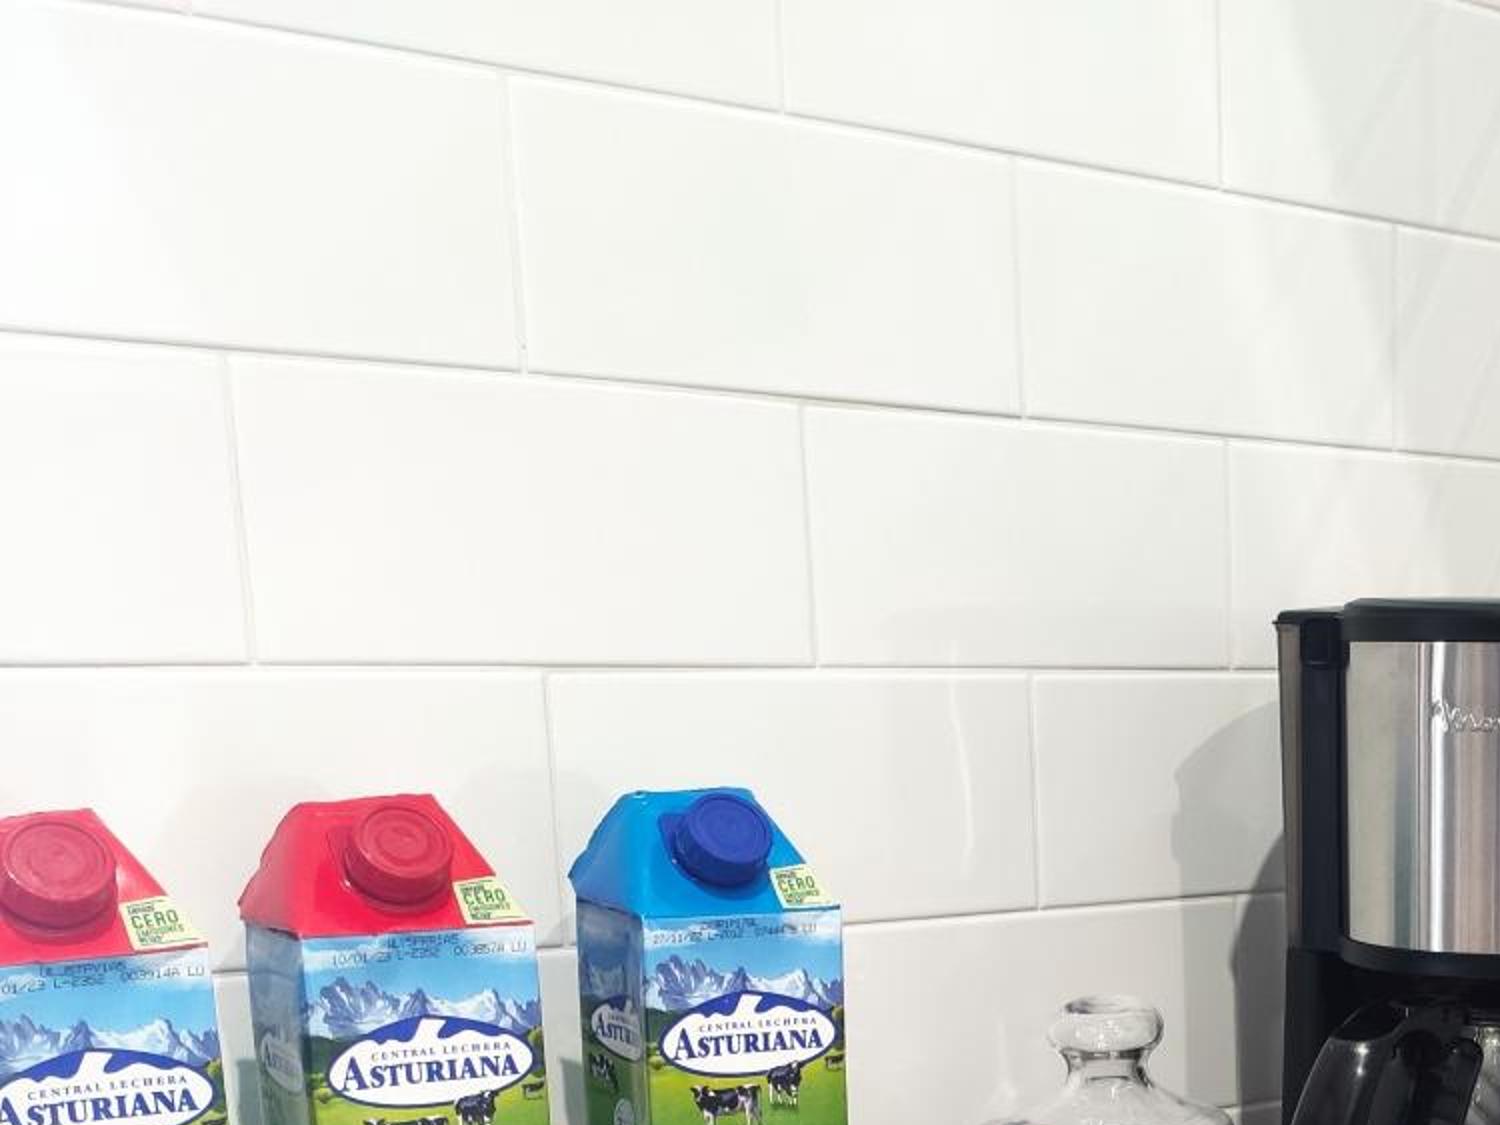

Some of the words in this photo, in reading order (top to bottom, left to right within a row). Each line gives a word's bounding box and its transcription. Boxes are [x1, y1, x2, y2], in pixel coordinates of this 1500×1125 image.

[780, 876, 815, 892] CERO
[463, 889, 506, 907] CERO
[130, 909, 180, 931] CERO
[699, 1020, 752, 1033] CENTRAL
[758, 1016, 817, 1029] LECHERA
[371, 1046, 436, 1062] CENTRAL
[443, 1041, 511, 1055] LECHERA
[673, 1027, 824, 1061] ASTURIANA
[342, 1053, 520, 1092] ASTURIANA
[27, 1083, 102, 1100] CENTRAL
[109, 1074, 188, 1091] LECHERA
